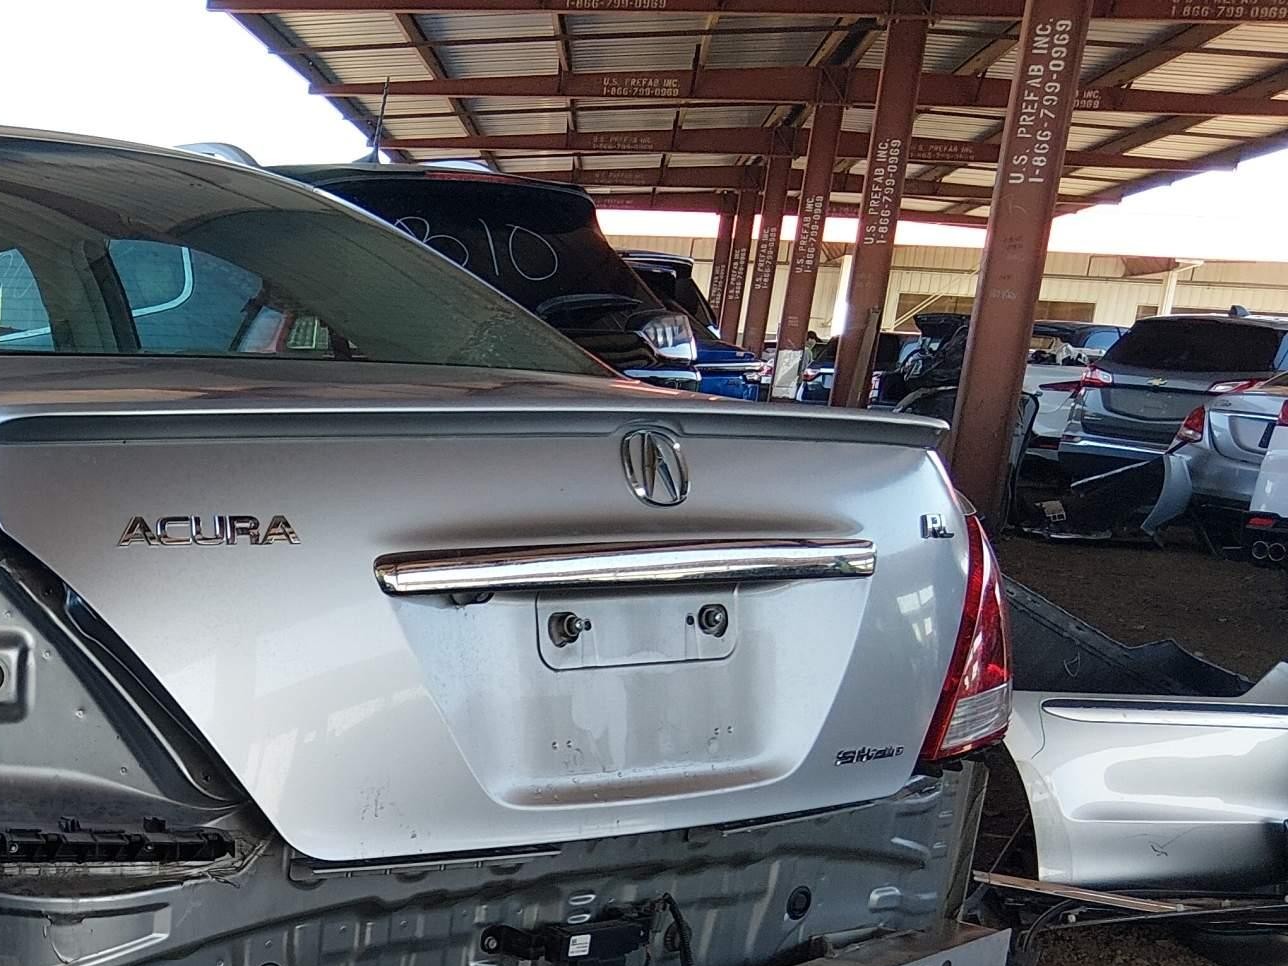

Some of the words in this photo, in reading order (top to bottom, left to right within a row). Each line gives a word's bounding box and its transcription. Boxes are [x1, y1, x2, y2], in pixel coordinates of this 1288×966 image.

[1032, 18, 1054, 54] INC.
[1017, 64, 1044, 138] PREFAB
[1028, 19, 1073, 183] 1-866-799-0969
[876, 138, 891, 162] INC.
[1009, 150, 1030, 184] U.S.
[868, 167, 885, 215] PREFAB
[876, 139, 902, 244] 1-866-799-0969
[798, 216, 812, 251] PREFAB
[864, 221, 879, 244] U.S.
[118, 515, 301, 547] ACURA
[920, 514, 954, 539] RL
